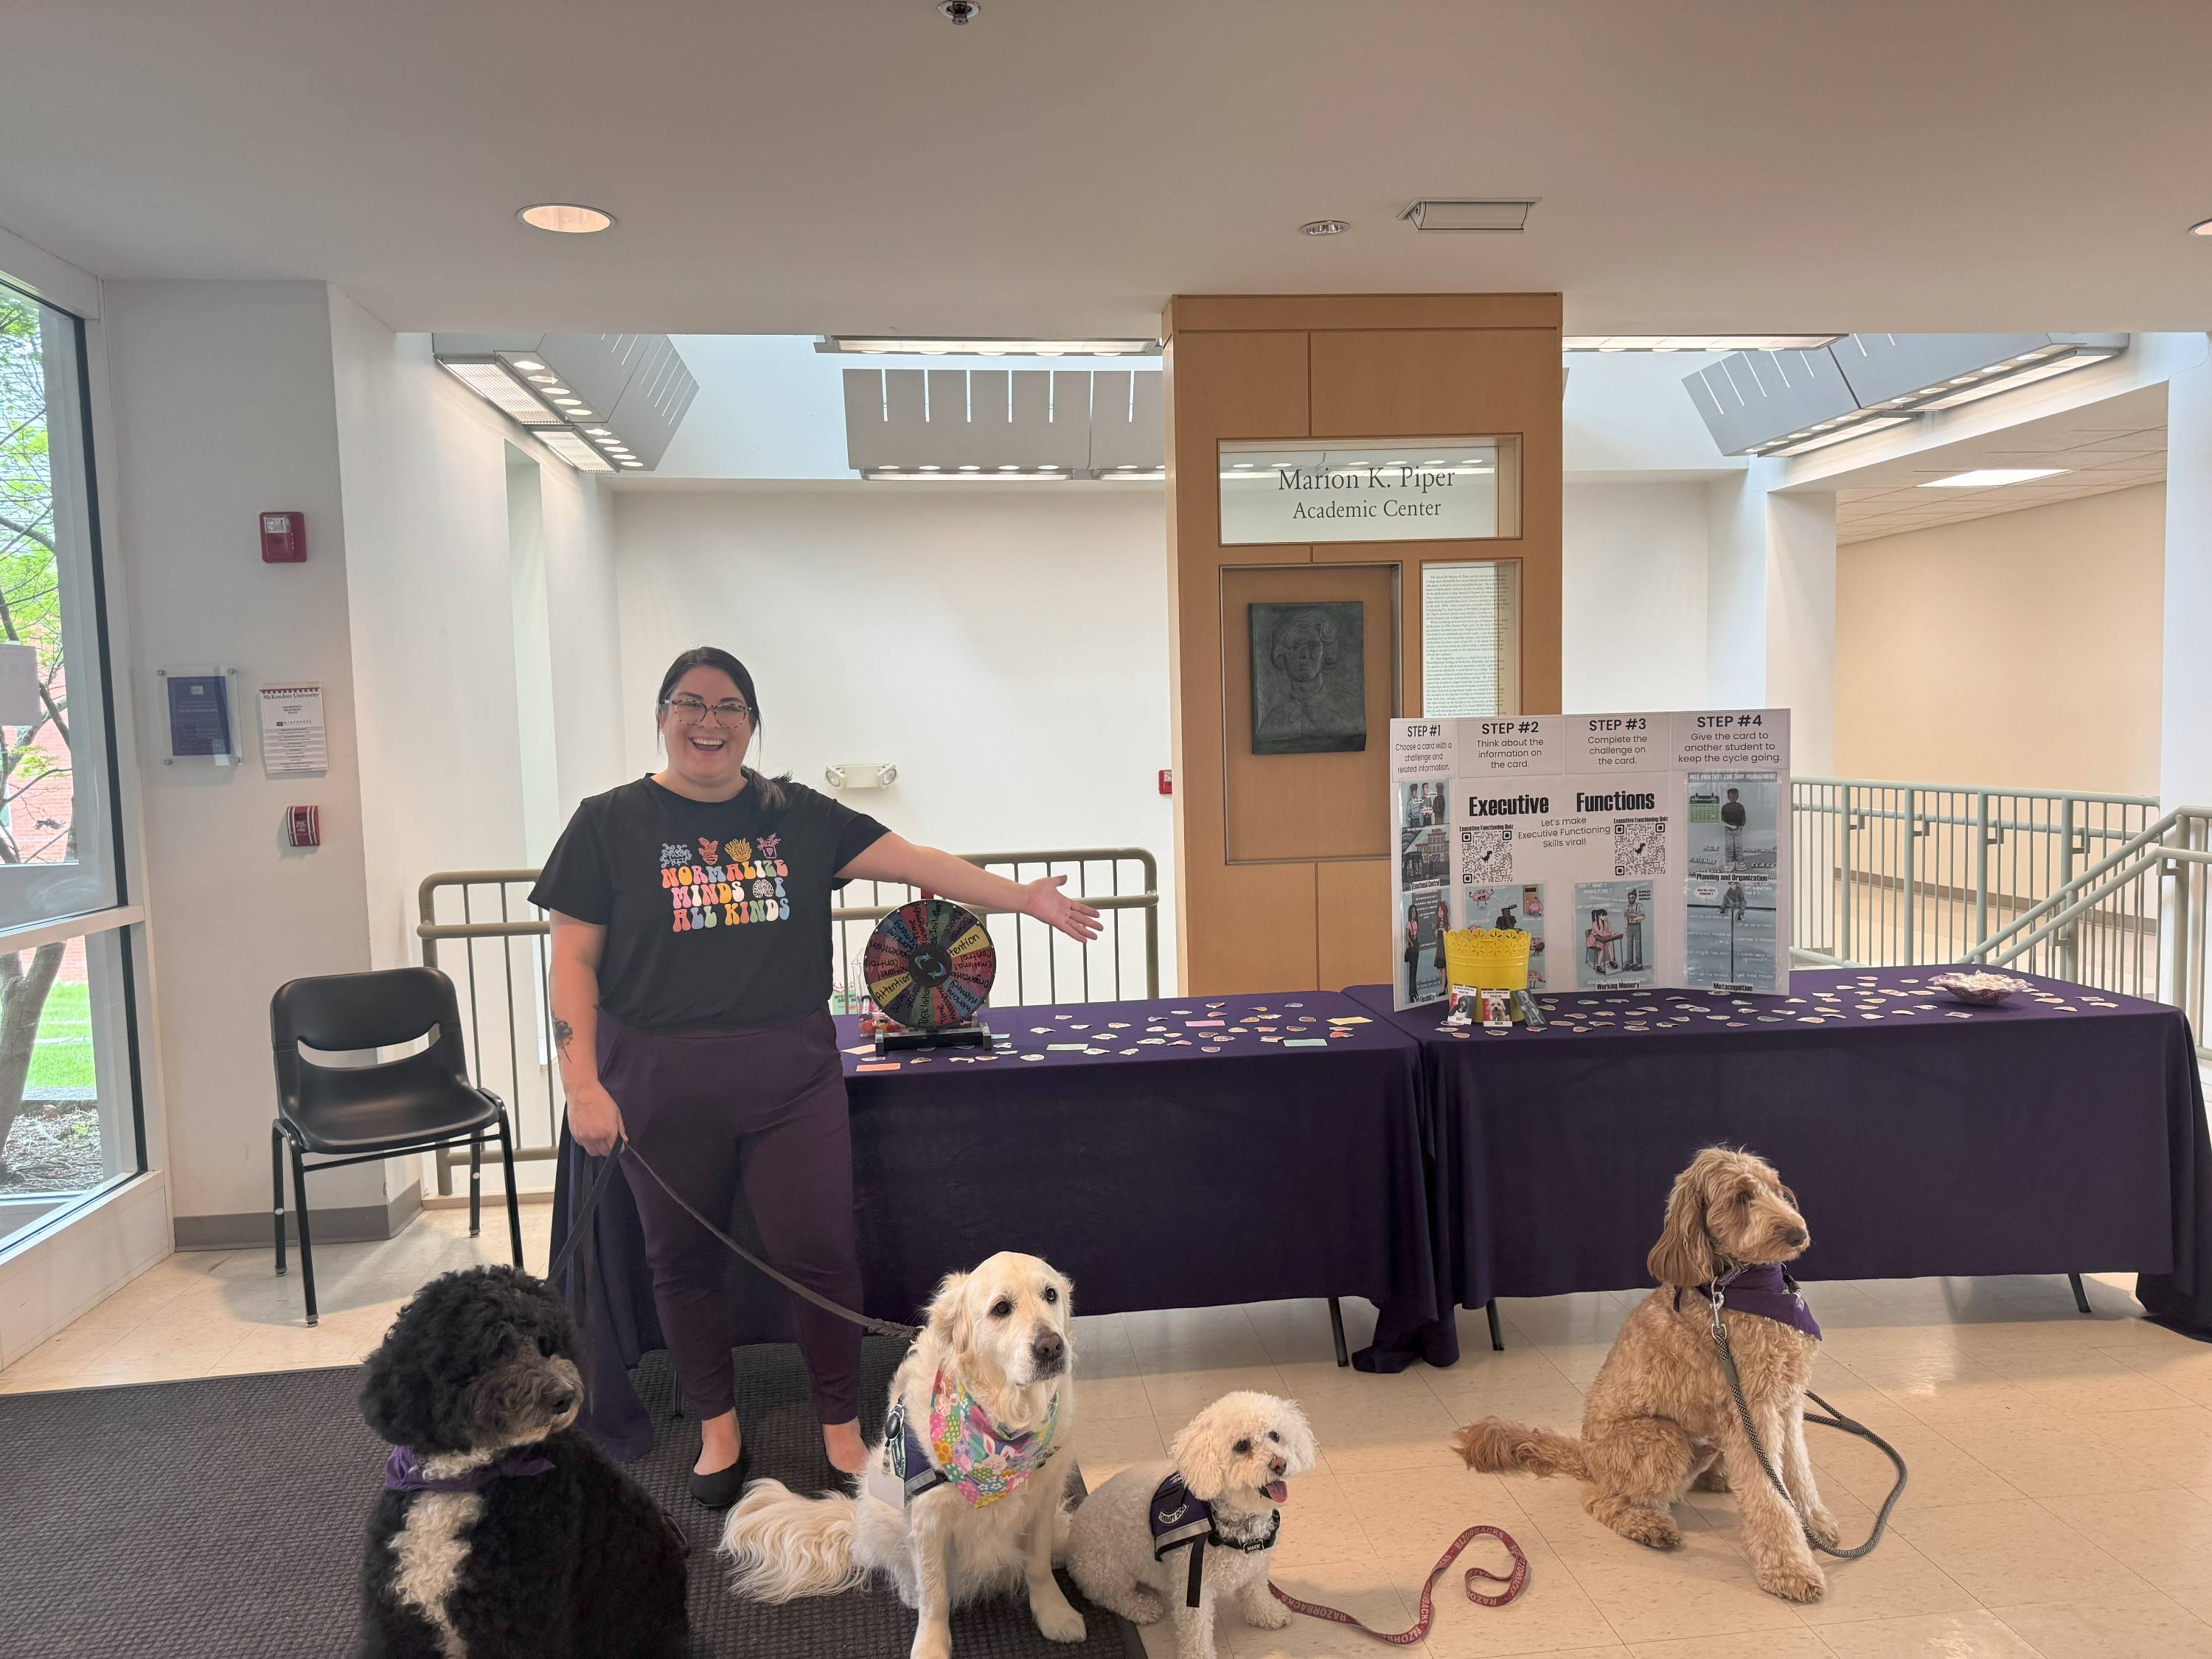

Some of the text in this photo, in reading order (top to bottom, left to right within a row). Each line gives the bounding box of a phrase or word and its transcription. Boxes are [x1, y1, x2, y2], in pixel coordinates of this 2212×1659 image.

[1278, 465, 1456, 493] Marion K. Piper
[1292, 498, 1441, 519] Academic Center
[1589, 718, 1646, 731] STEP #3
[1697, 714, 1762, 728] STEP #4
[1408, 724, 1441, 737] STEP #1
[1482, 721, 1539, 734] STEP #2
[1587, 734, 1647, 745] Complete the
[1691, 732, 1712, 741] Give
[1714, 732, 1731, 740] the
[1733, 731, 1756, 740] card
[1395, 742, 1416, 751] Choose
[1422, 742, 1434, 750] card
[1436, 741, 1447, 749] with
[1477, 737, 1544, 748] Think about the
[1684, 743, 1722, 751] another
[1725, 742, 1763, 751] student
[1478, 749, 1528, 758] information
[1589, 745, 1632, 755] challenge
[1405, 752, 1443, 762] challenge and
[1615, 757, 1637, 765] card.
[1679, 753, 1782, 765] keep the cycle going.
[1397, 763, 1450, 773] related information.
[1507, 759, 1529, 768] card.
[1470, 790, 1655, 816] Executive Functions
[1541, 817, 1587, 827] Let's make
[1518, 826, 1610, 839] Executive Functioning
[1543, 838, 1586, 848] Skills viral!
[661, 859, 788, 888] NORMALIZE
[1696, 874, 1719, 882] Planning
[1731, 874, 1768, 882] Organization
[671, 881, 745, 909] MINDS
[672, 897, 790, 932] ALL KINDS
[948, 934, 980, 956] tention
[960, 950, 991, 962] Control
[869, 959, 898, 972] Control
[954, 961, 992, 971] Emotional
[950, 979, 978, 1004] Memory
[1618, 981, 1640, 990] Memory
[1714, 983, 1753, 992] Metacognition
[947, 986, 971, 1012] Working
[1160, 1512, 1175, 1523] THERAPY
[1455, 1527, 1505, 1550] RAZORBACKS
[1511, 1557, 1526, 1597] ZORBACKS
[1281, 1594, 1347, 1622] RAZORBACKS
